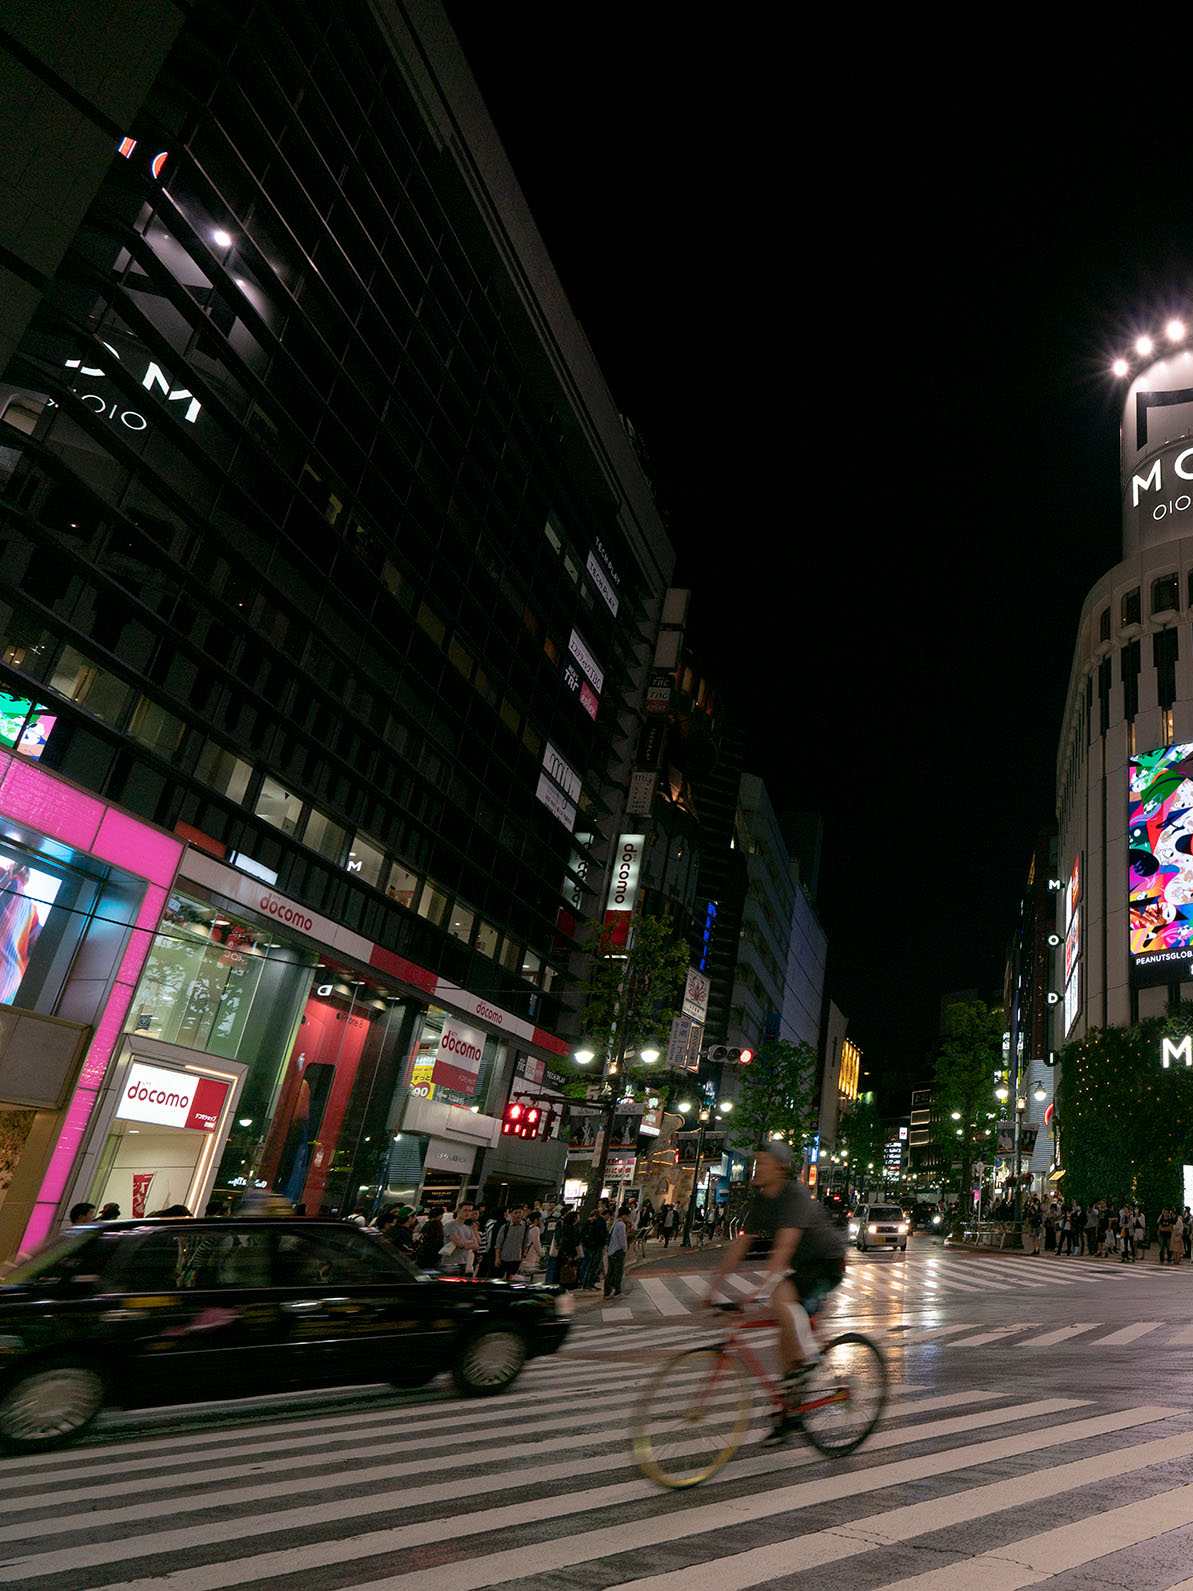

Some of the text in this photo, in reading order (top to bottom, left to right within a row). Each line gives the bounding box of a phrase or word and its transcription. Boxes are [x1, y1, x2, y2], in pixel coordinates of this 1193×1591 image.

[615, 843, 638, 904] docomo
[259, 893, 313, 932] docomo
[475, 1000, 503, 1025] docomo
[441, 1029, 482, 1062] docomo
[127, 1080, 189, 1108] docomo
